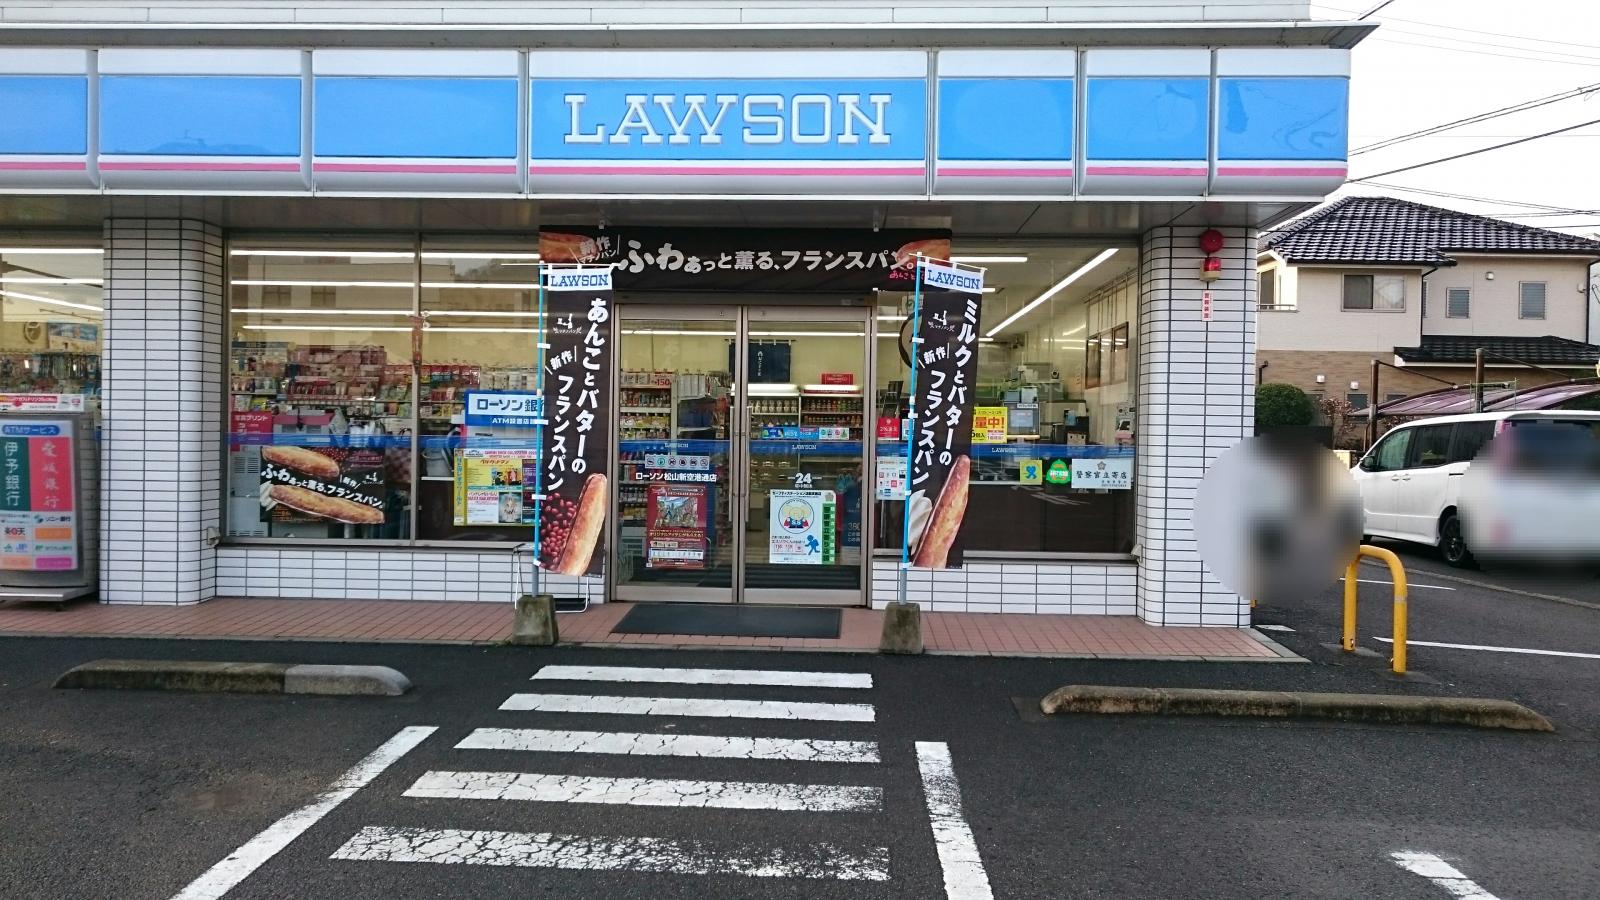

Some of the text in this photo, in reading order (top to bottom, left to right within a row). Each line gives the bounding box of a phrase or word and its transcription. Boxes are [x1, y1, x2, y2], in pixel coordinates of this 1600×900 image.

[564, 94, 893, 145] LAWSON
[550, 273, 609, 287] LAWSON
[927, 268, 981, 290] LAWSON
[550, 350, 573, 371] 新作
[923, 345, 947, 365] 新作
[571, 298, 609, 475] あんことバターの
[939, 298, 979, 467] ミルクとバターの
[547, 374, 574, 492] フランスパン
[912, 369, 946, 486] フランスパン
[4, 440, 20, 507] 伊予銀行
[795, 472, 812, 484] 24
